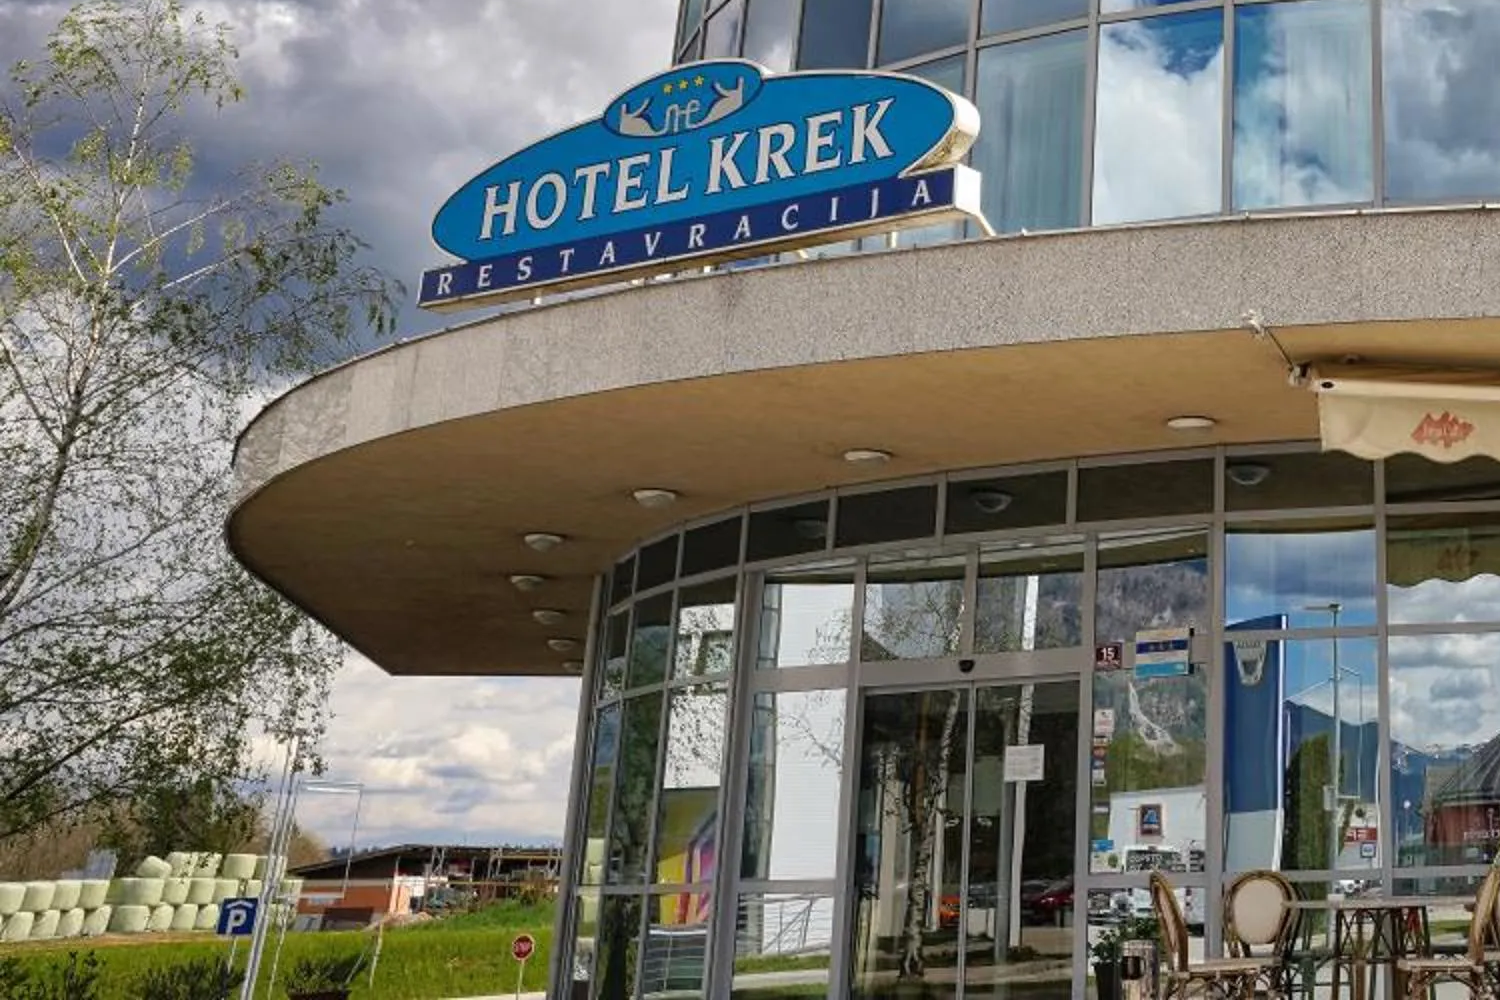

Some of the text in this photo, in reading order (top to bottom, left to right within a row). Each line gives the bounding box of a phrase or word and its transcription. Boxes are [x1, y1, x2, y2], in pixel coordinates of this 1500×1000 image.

[478, 96, 896, 242] HOTEL KREK
[435, 179, 932, 295] RESTAVRACIJA
[1100, 647, 1116, 661] 15
[225, 909, 247, 934] P
